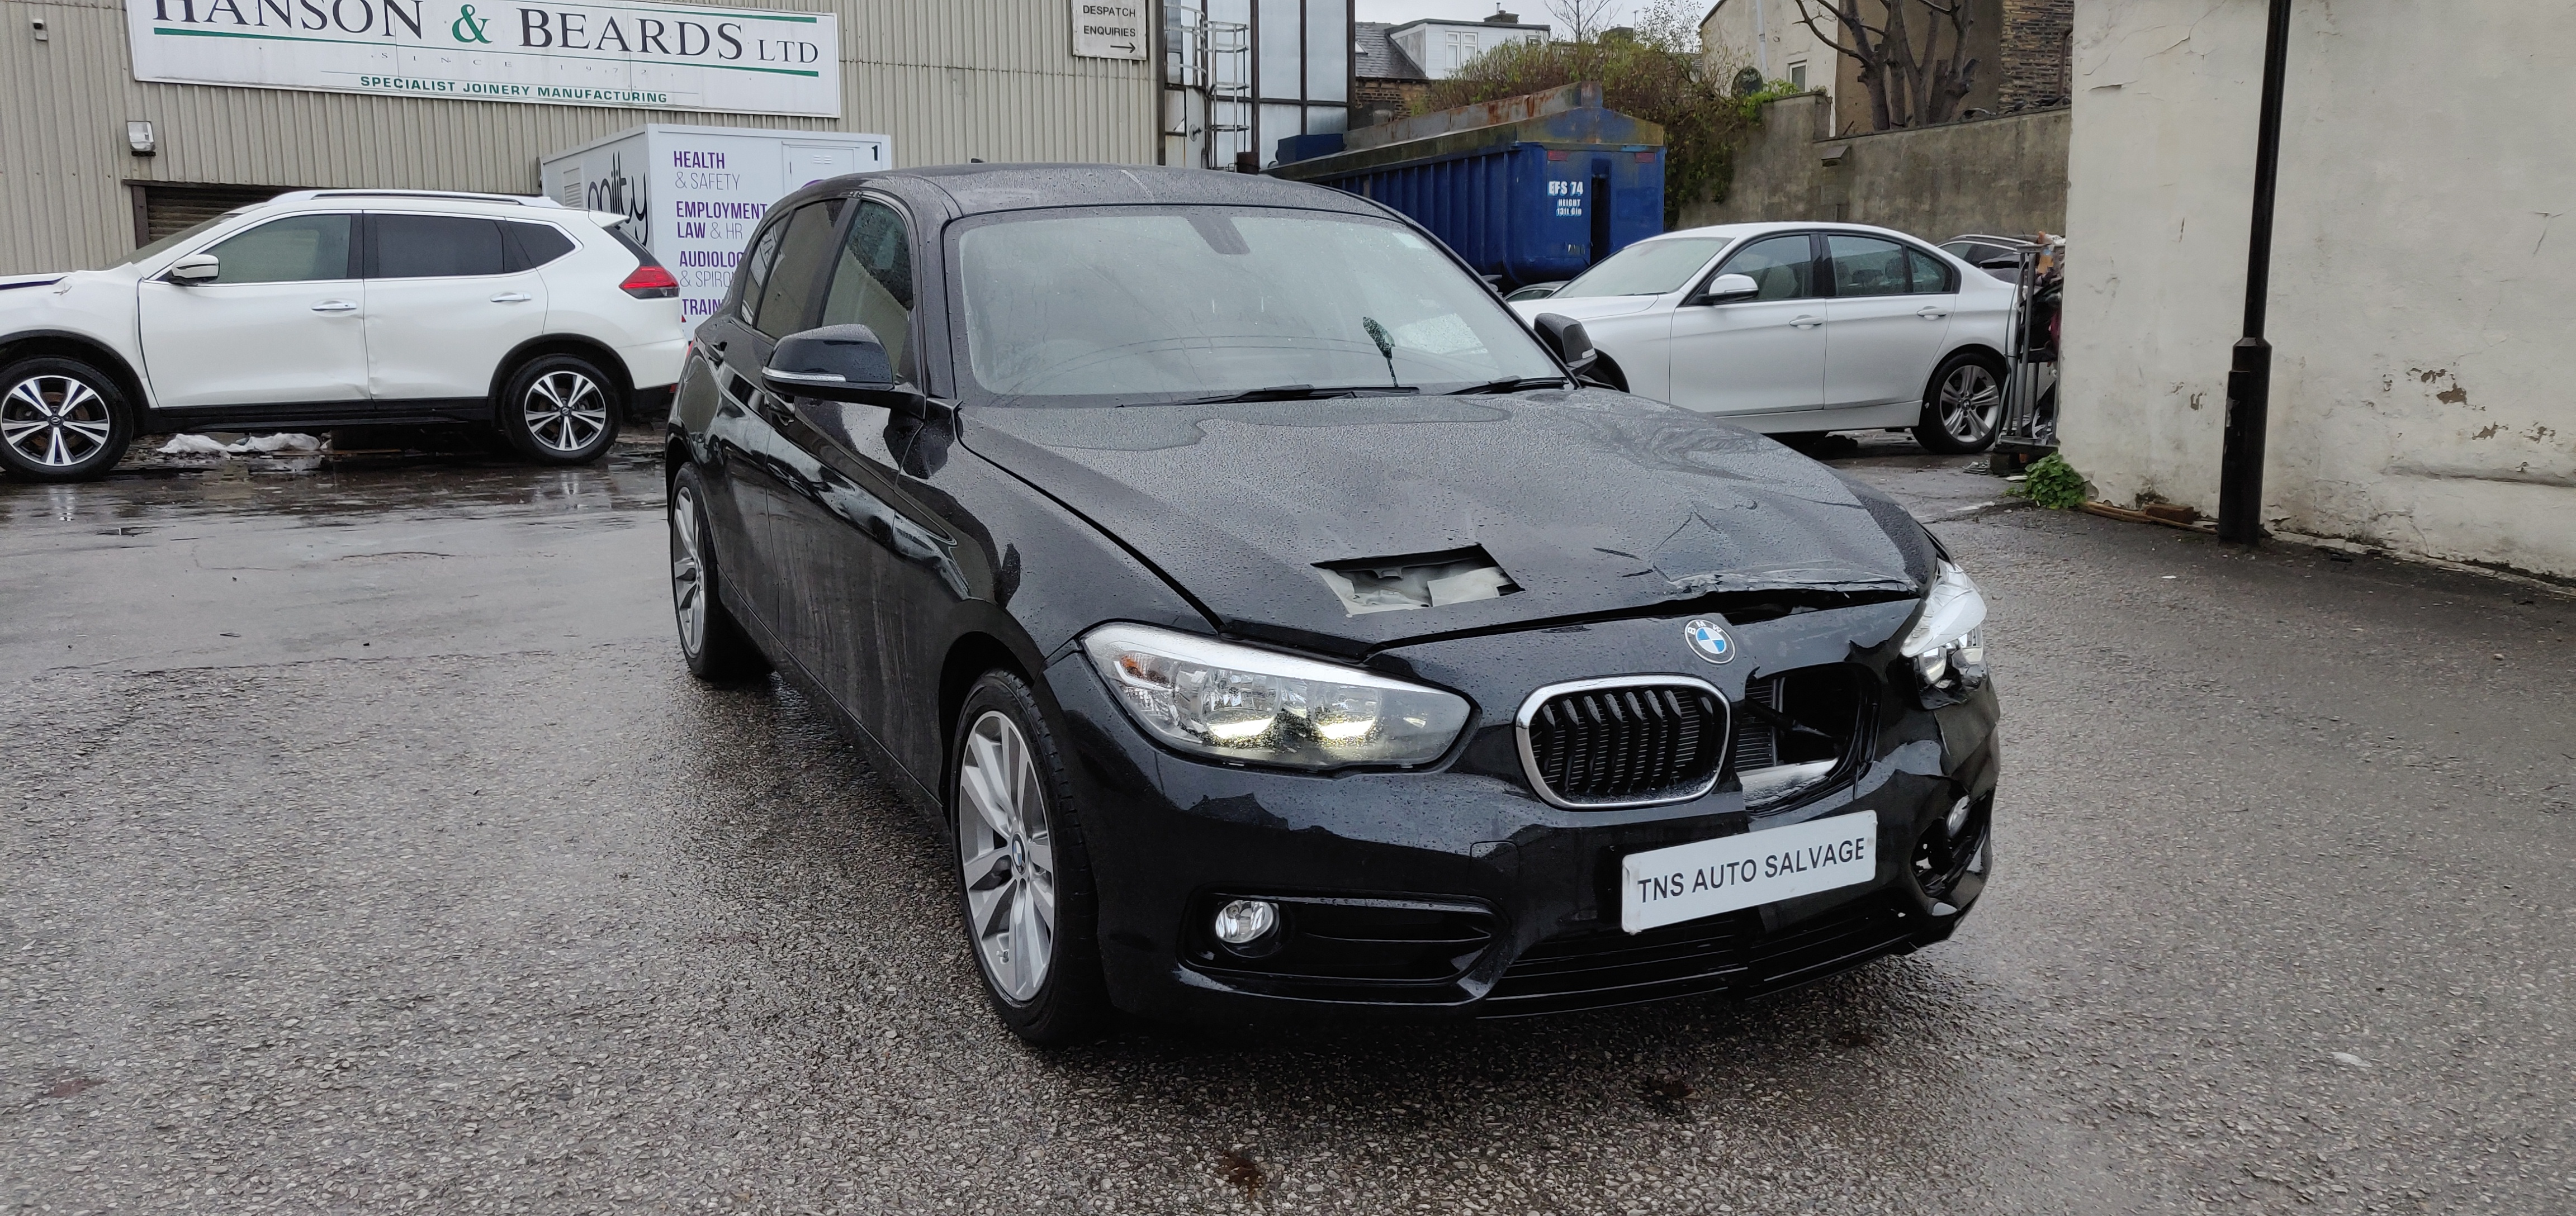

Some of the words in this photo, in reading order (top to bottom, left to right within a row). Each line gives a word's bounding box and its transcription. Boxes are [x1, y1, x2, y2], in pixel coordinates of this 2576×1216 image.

[1083, 5, 1136, 18] DESPATCH
[153, 0, 424, 40] HANSON
[452, 4, 493, 44] &
[518, 7, 744, 60] BEARDS
[756, 39, 819, 64] LTD
[1083, 25, 1136, 37] ENQUIRIES
[360, 75, 455, 92] SPECIALIST
[463, 83, 530, 96] JOINERY
[537, 87, 667, 103] MANUFACTURING
[673, 150, 725, 169] HEALTH
[871, 145, 878, 162] 1
[675, 171, 688, 189] &
[690, 172, 740, 191] SAFETY
[1548, 180, 1568, 196] EFS
[1570, 181, 1584, 196] 74
[676, 201, 768, 220] EMPLOYMENT
[1557, 198, 1581, 207] HEIGHT
[676, 221, 706, 239] LAW
[710, 222, 722, 239] &
[726, 222, 743, 240] HR
[680, 270, 692, 288] &
[695, 270, 735, 288] SPIRO
[1687, 620, 1722, 635] BMW
[1638, 872, 1685, 904] TNS
[1692, 858, 1757, 894] AUTO
[1764, 837, 1865, 879] SALVAGE
